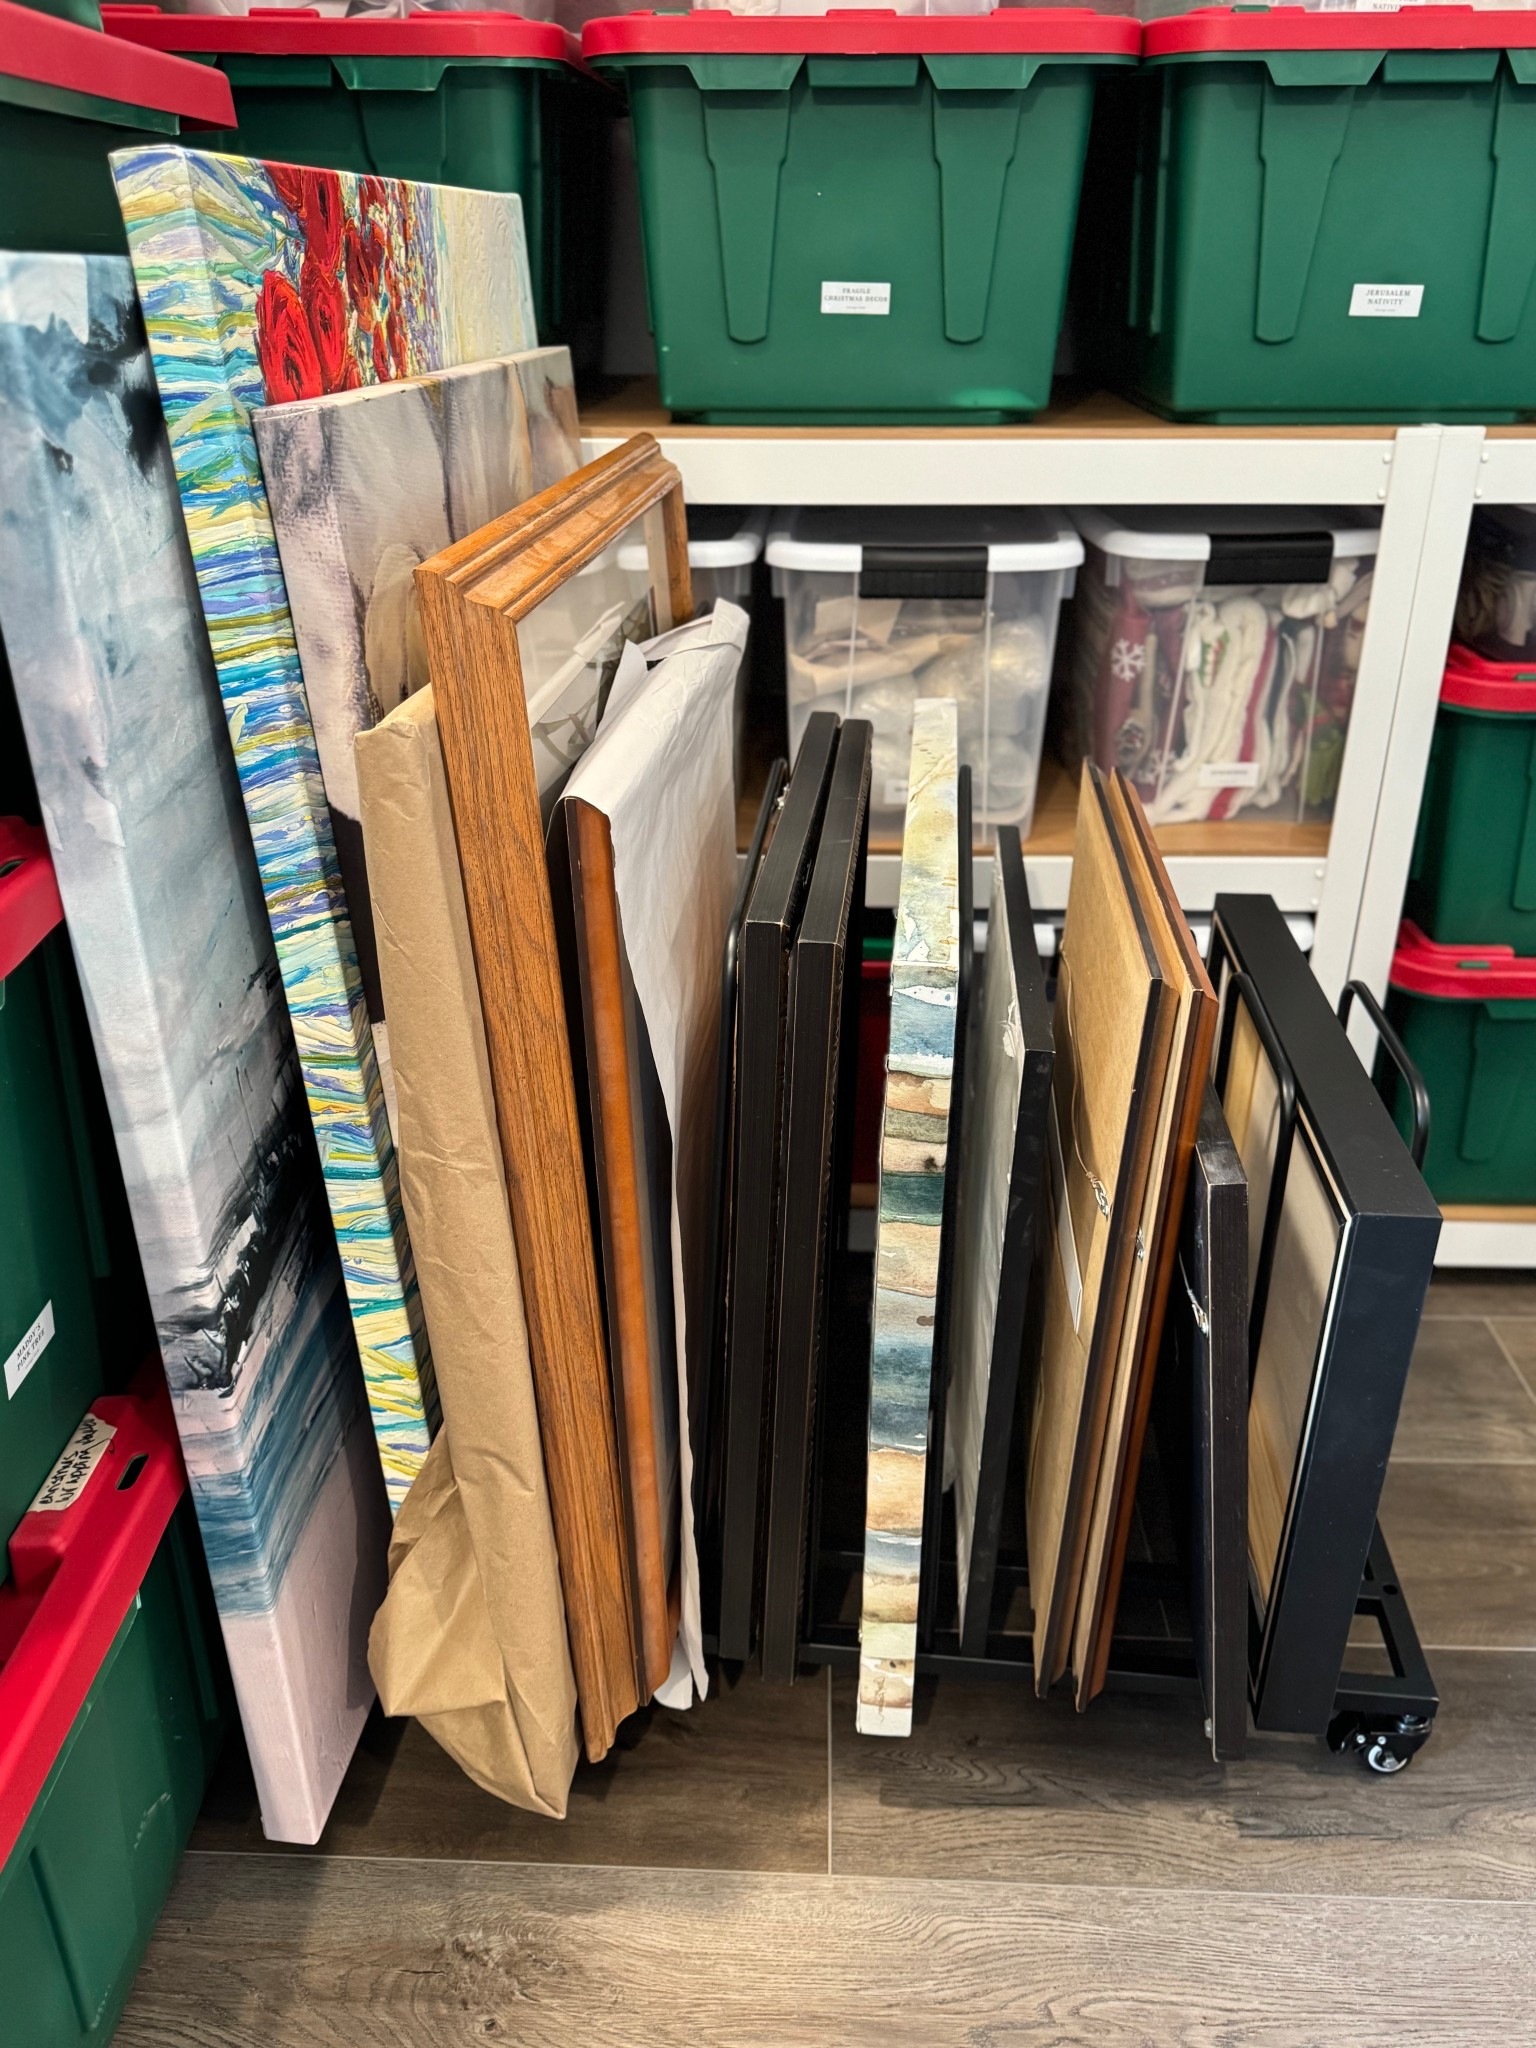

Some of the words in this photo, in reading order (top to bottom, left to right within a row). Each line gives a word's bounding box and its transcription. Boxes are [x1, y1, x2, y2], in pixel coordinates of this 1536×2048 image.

[1365, 289, 1411, 297] JERUSALEM
[16, 1322, 41, 1360] MADDY'S
[17, 1349, 31, 1371] PINK
[31, 1327, 45, 1349] TREE
